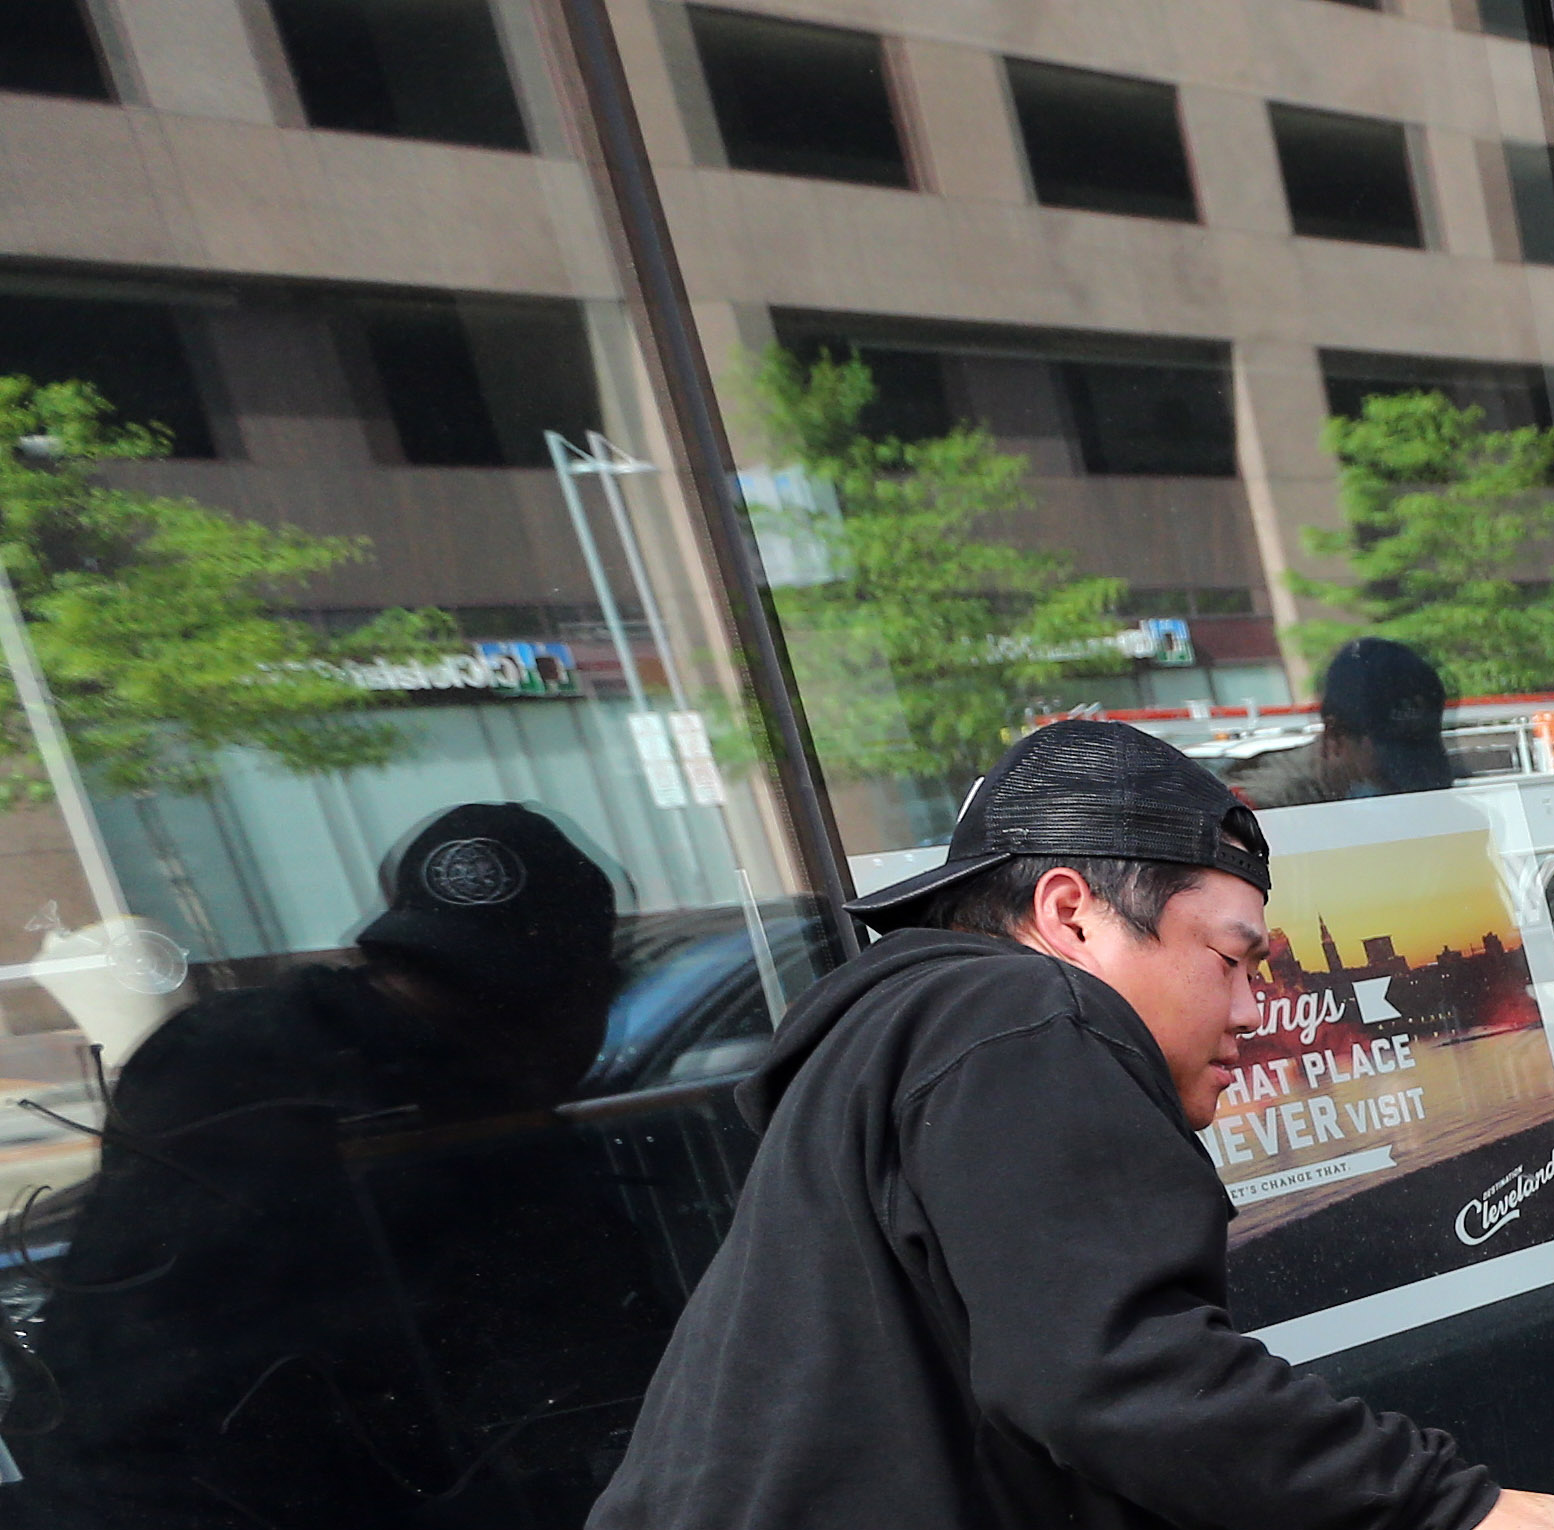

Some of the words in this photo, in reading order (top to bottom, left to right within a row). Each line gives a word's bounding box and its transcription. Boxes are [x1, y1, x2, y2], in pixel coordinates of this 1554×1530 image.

[1236, 987, 1346, 1045] ings
[1216, 1058, 1291, 1110] HAT
[1302, 1033, 1416, 1089] PLACE
[1344, 1087, 1427, 1134] VISIT
[1230, 1185, 1257, 1199] ET'S
[1261, 1171, 1313, 1191] CHANGE
[1315, 1162, 1351, 1178] THAT.
[1482, 1164, 1523, 1200] DESTINATION
